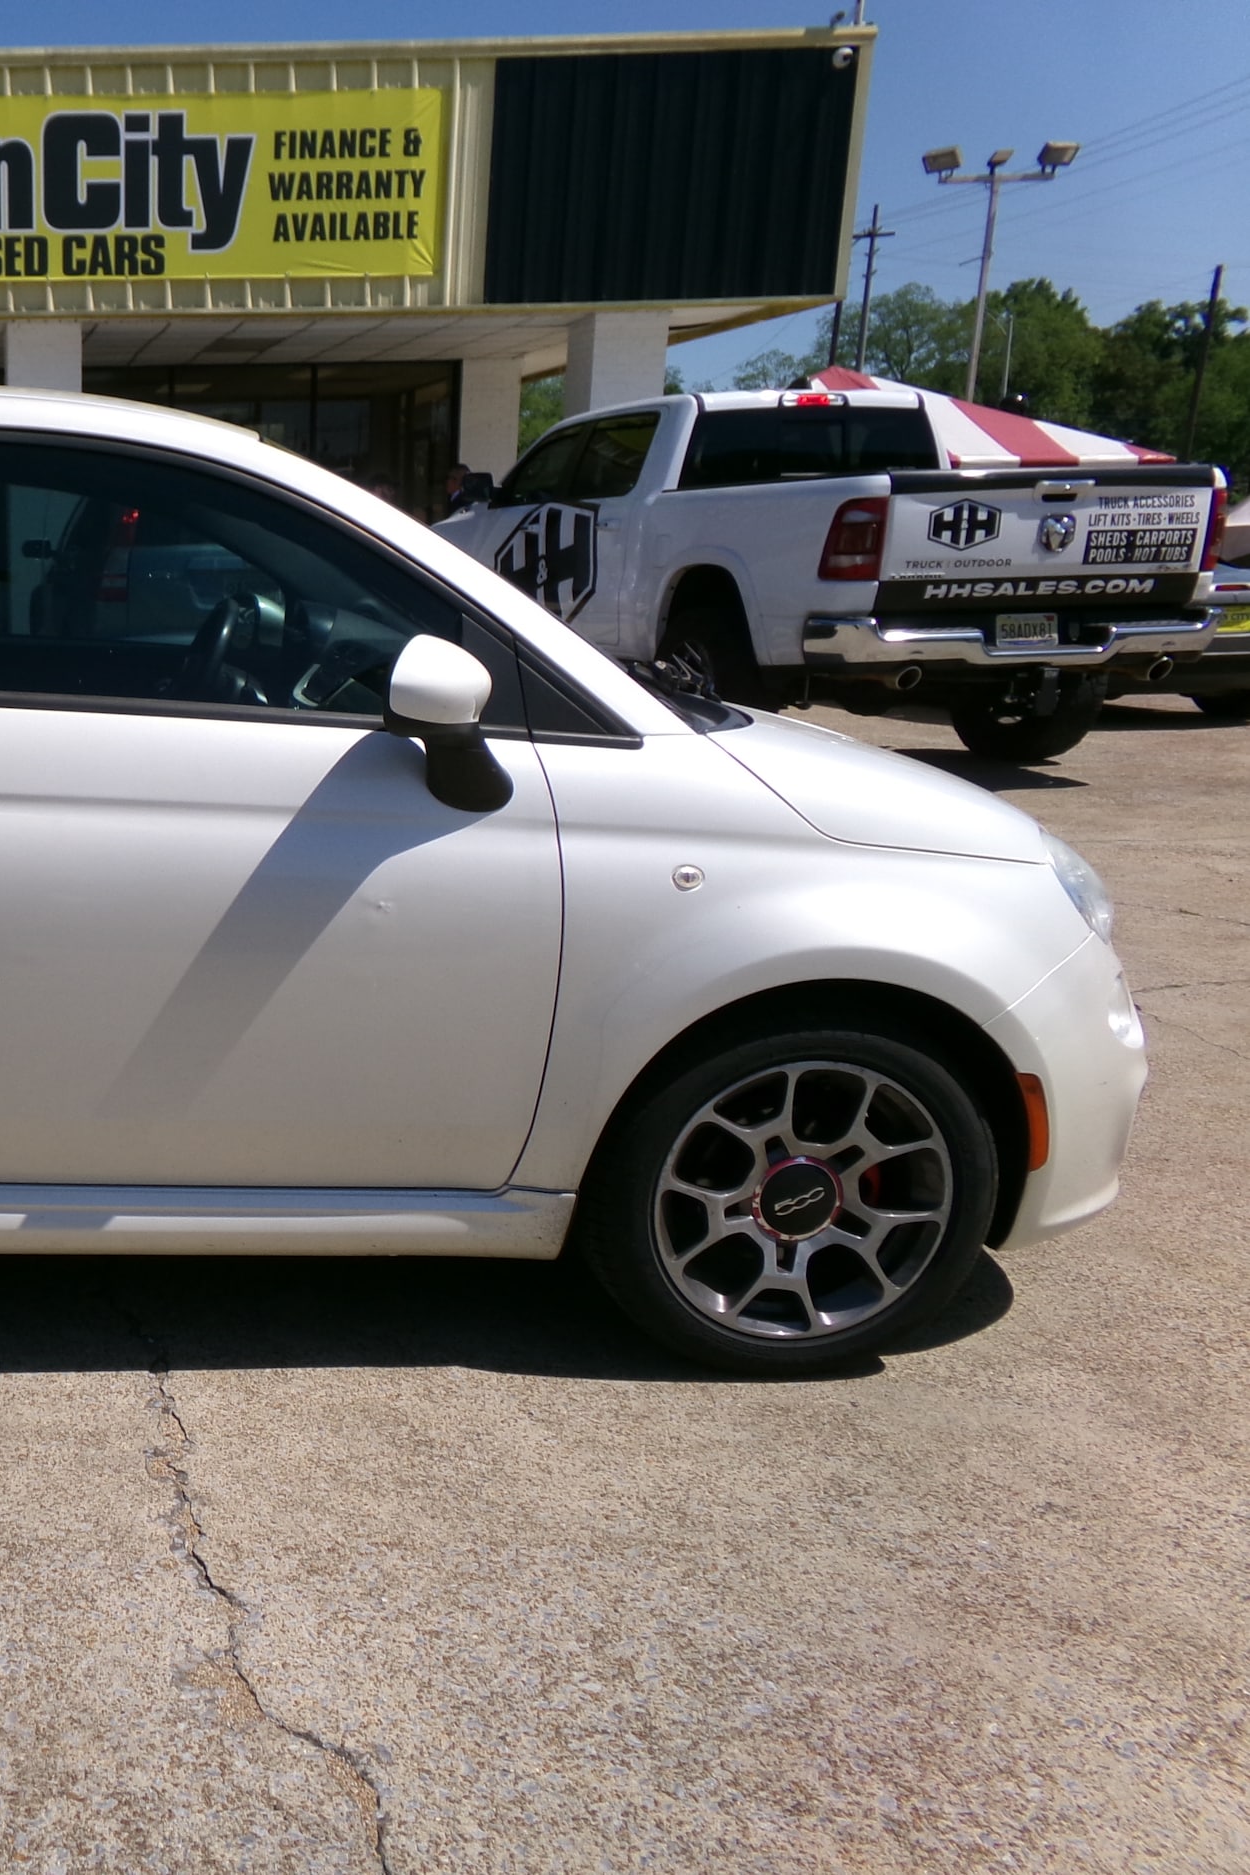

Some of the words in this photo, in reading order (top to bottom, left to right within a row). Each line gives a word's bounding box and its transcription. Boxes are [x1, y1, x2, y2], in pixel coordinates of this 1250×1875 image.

[273, 129, 392, 160] FINANCE
[402, 128, 422, 157] &
[268, 169, 426, 202] WARRANTY
[273, 211, 419, 243] AVAILABLE
[62, 234, 166, 276] CARS
[1098, 496, 1130, 509] TRUCK
[1133, 495, 1195, 508] ACCESSORIES
[1088, 513, 1108, 526] LIFT
[1110, 513, 1131, 526] KITS
[1137, 513, 1162, 526] TIRES
[1168, 511, 1200, 524] WHEELS
[1090, 532, 1128, 546] SHEDS
[1136, 530, 1193, 545] CARPORTS
[1089, 549, 1126, 562] POOLS
[1132, 548, 1156, 561] HOT
[1160, 547, 1188, 560] TUBS
[906, 560, 943, 569] TRUCK
[954, 559, 1012, 568] OUTDOOR
[924, 579, 1154, 599] HHSALES.COM
